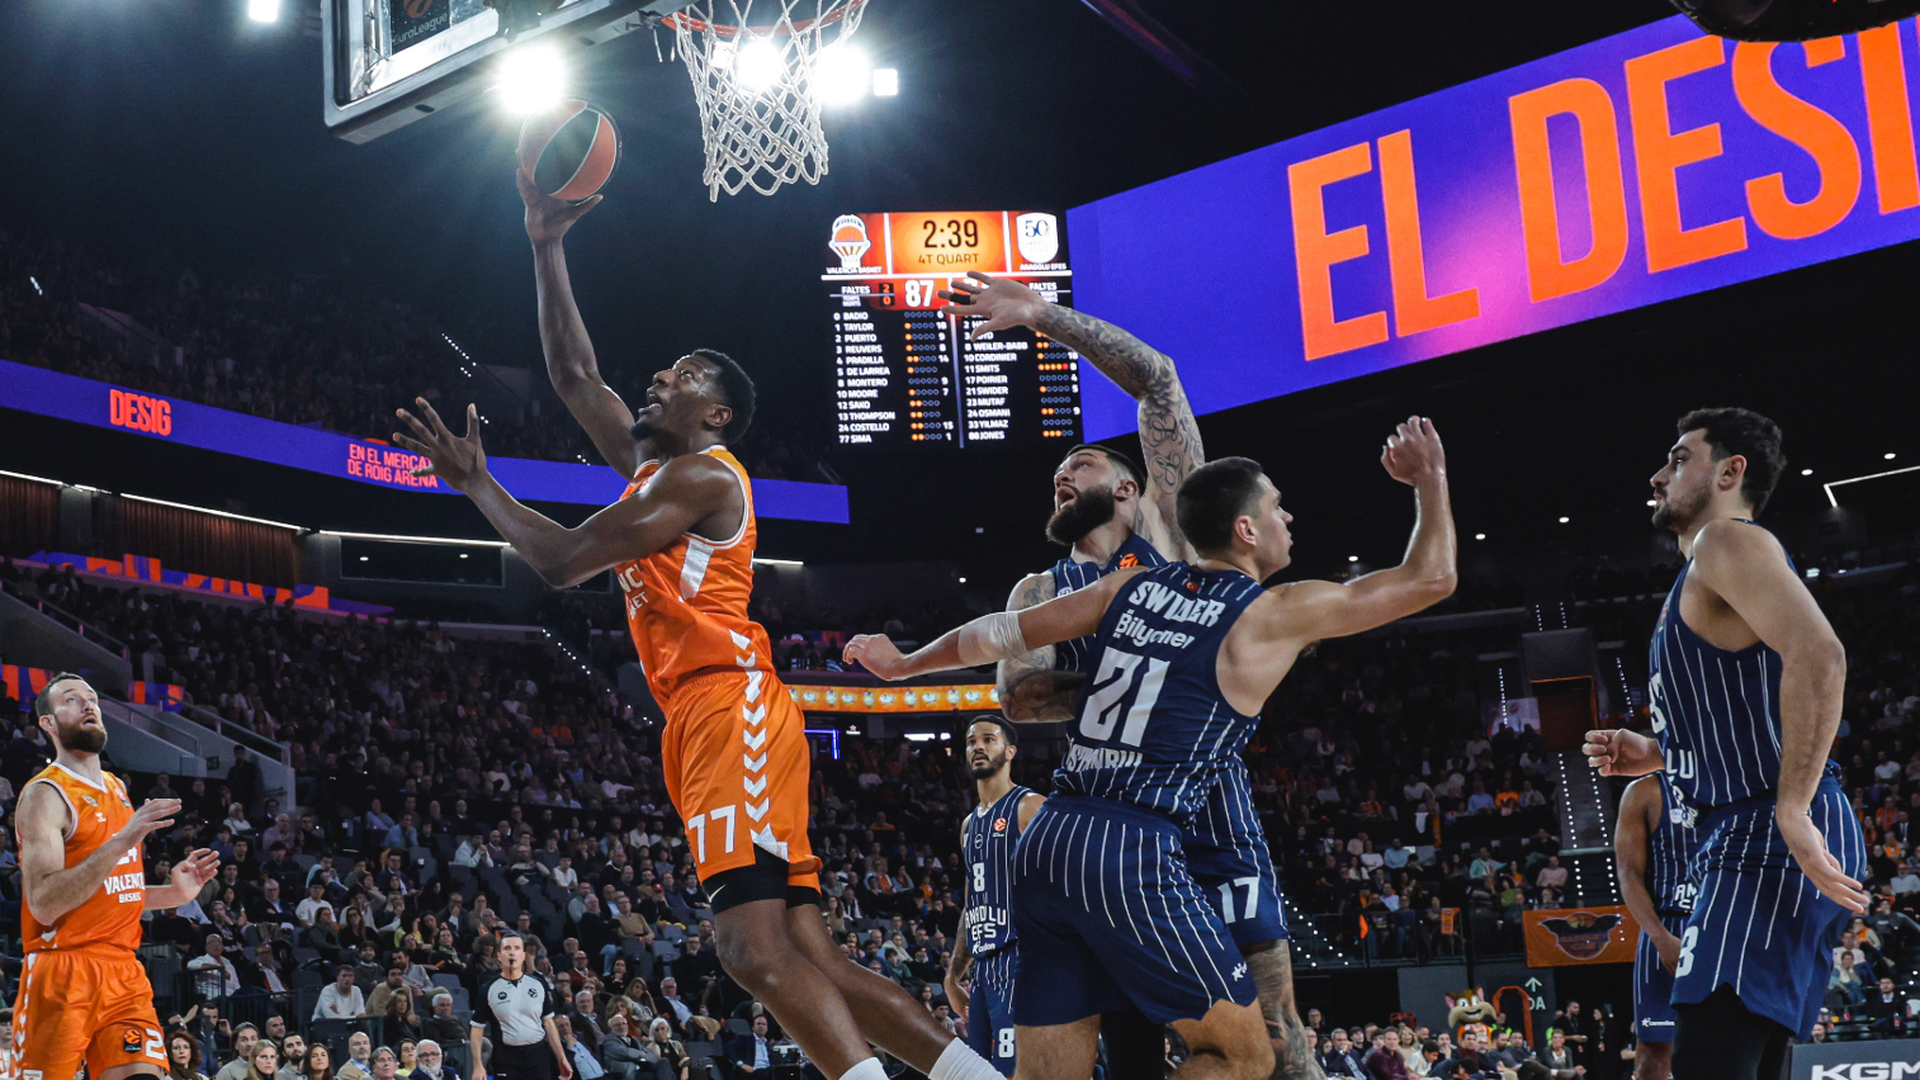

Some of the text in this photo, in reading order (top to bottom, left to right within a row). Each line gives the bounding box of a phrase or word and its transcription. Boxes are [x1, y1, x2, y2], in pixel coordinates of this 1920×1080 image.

[1288, 14, 1920, 361] EL DESI
[923, 220, 978, 248] 2:39
[918, 253, 979, 265] 4T QUART
[841, 283, 890, 294] FALTES 2
[1028, 282, 1057, 291] FALTES
[904, 280, 934, 308] 87
[883, 296, 891, 305] 0
[834, 312, 840, 321] 0
[843, 312, 868, 320] BADIO
[844, 323, 874, 331] TAYLOR
[964, 321, 970, 329] 2
[835, 334, 841, 342] 2
[844, 334, 877, 342] PUERTO
[836, 346, 842, 354] 3
[845, 345, 882, 353] REUVERS
[973, 342, 1028, 350] WEILER-BABB
[837, 357, 843, 365] 4
[846, 356, 884, 364] PRADILLA
[964, 354, 974, 362] 10
[975, 353, 1017, 361] CORDINIER
[837, 367, 890, 376] 5 DE LARREA
[965, 365, 974, 373] 11
[976, 364, 1000, 372] SMITS
[847, 378, 888, 387] MONTERO
[965, 376, 976, 384] 17
[976, 375, 1008, 383] POIRIER
[837, 390, 847, 398] 10
[848, 389, 878, 398] MOORE
[977, 387, 1008, 395] SWIDER
[848, 401, 870, 409] SAKO
[978, 398, 1005, 406] MUTAF
[110, 389, 171, 436] DESIG
[838, 412, 895, 421] 13 THOMPSON
[967, 410, 978, 418] 24
[838, 424, 849, 432] 24
[850, 423, 889, 432] COSTELLO
[968, 421, 979, 429] 33
[839, 435, 850, 443] 77
[851, 434, 872, 442] SIMA
[980, 431, 1005, 439] JONES
[349, 444, 365, 461] EN
[367, 448, 382, 465] EL
[347, 459, 363, 477] DE
[365, 463, 392, 483] ROIG
[1079, 646, 1171, 748] 21
[687, 804, 737, 864] 77
[973, 862, 985, 892] 8
[1217, 876, 1260, 925] 17
[999, 1028, 1014, 1058] 8
